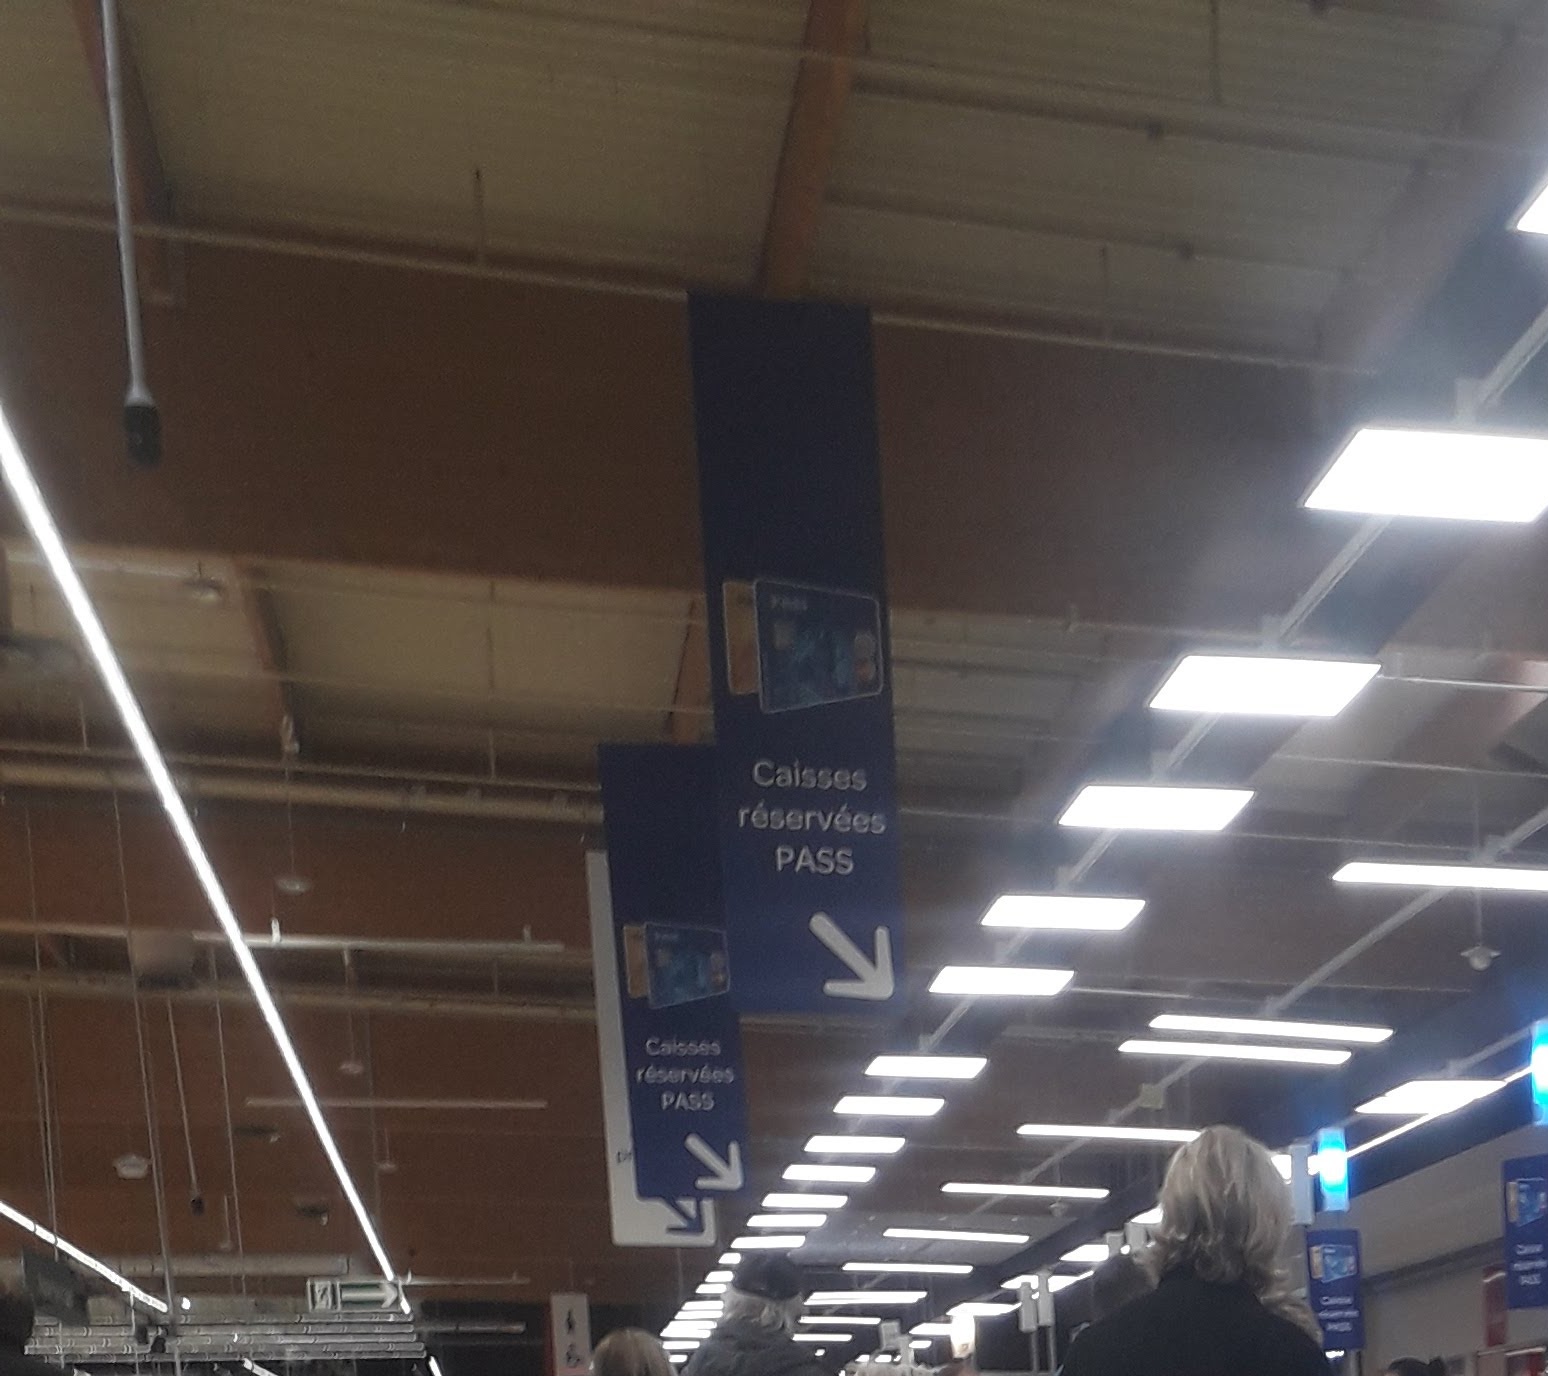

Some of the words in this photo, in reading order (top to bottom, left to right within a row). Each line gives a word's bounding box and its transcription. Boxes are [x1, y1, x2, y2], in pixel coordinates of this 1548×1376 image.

[753, 758, 868, 791] Caisses
[738, 799, 887, 834] réservées
[776, 845, 854, 875] PASS
[646, 1036, 721, 1056] Caisses
[661, 1091, 715, 1111] PASS
